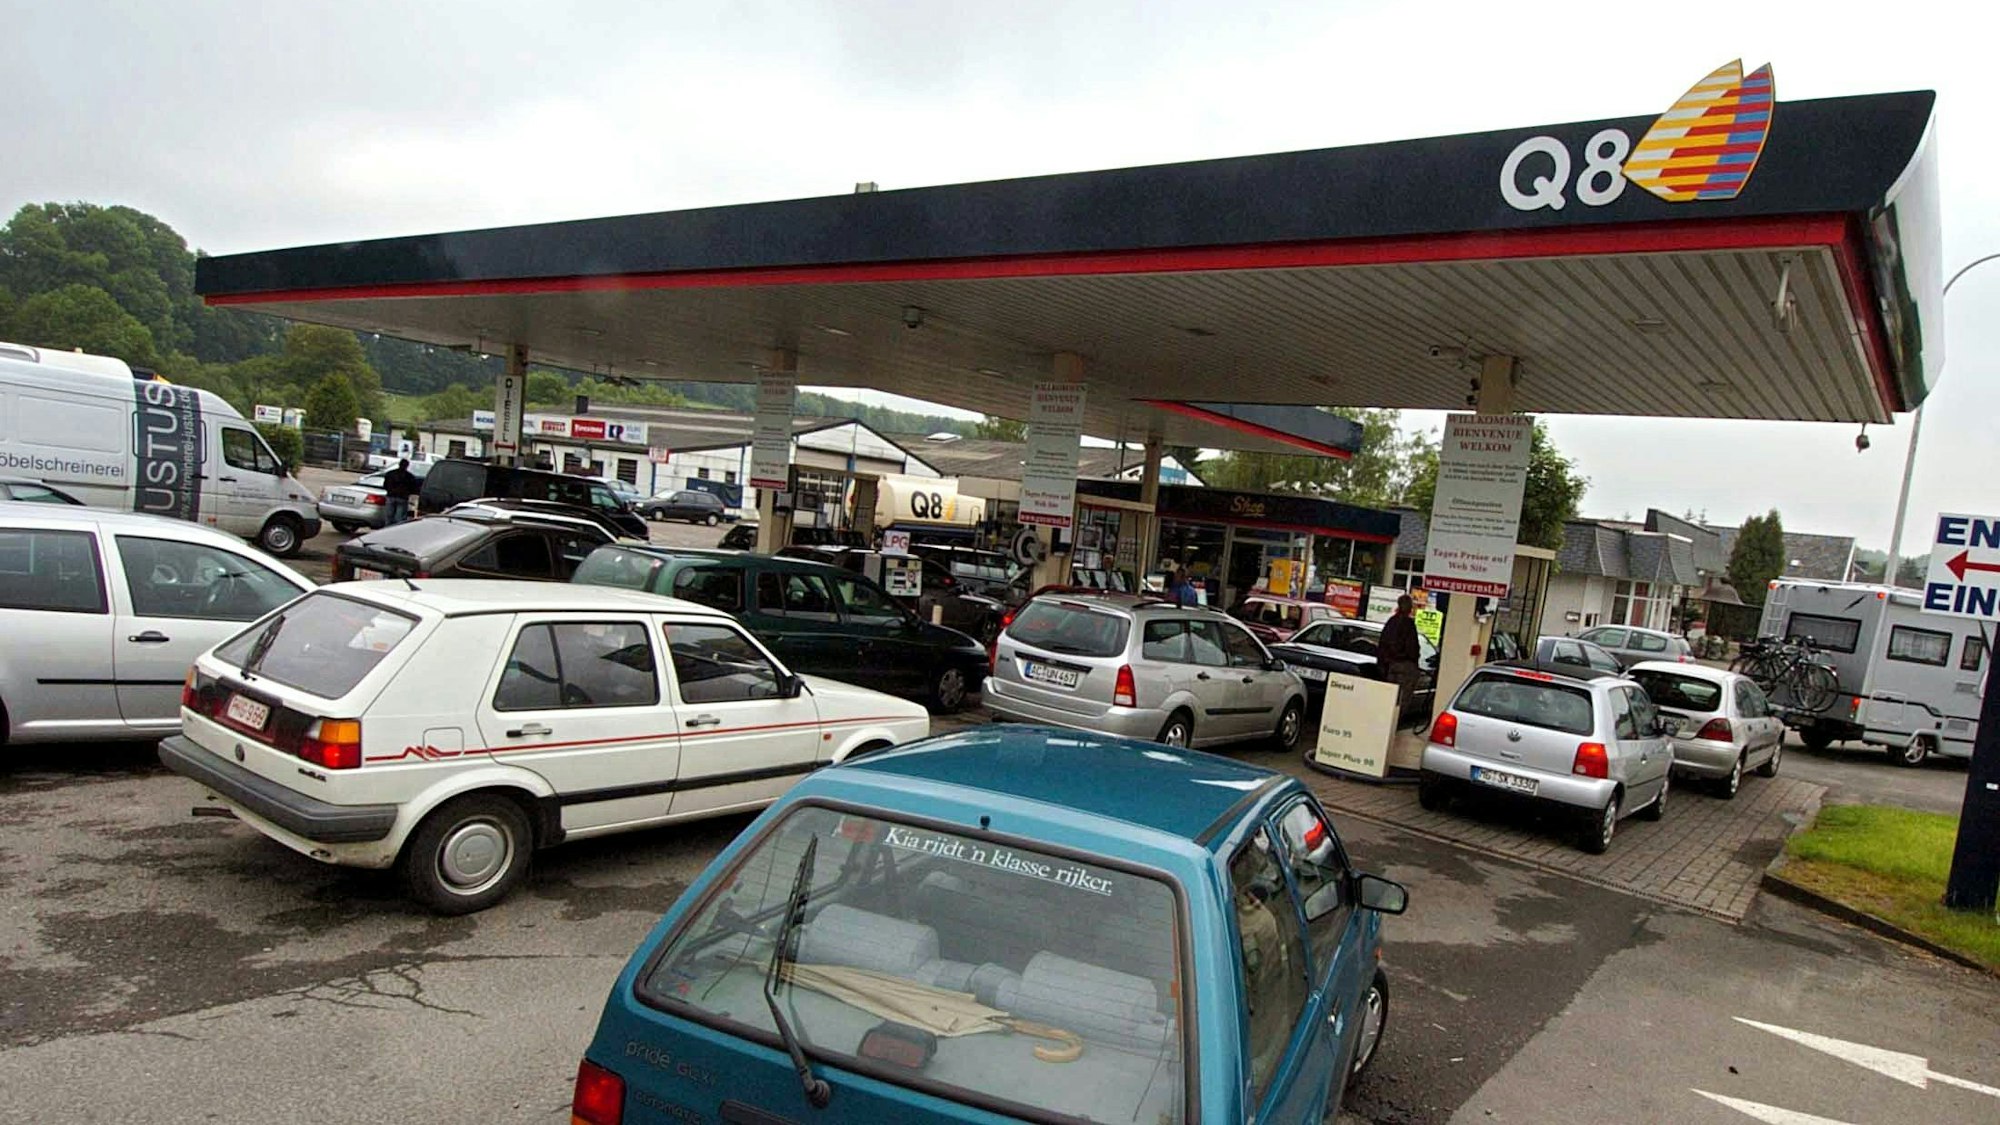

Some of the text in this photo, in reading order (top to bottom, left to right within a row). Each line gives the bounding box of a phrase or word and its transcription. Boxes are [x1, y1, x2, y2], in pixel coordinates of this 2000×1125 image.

[1500, 129, 1630, 211] Q8
[1447, 415, 1531, 427] WILLKOMMEN
[1453, 428, 1523, 440] BIENVENUE
[1459, 441, 1512, 453] WELKOM
[0, 451, 124, 477] öbelschreinerei
[911, 490, 943, 519] Q8
[883, 535, 909, 549] LPG
[1433, 548, 1508, 564] Tages Preise auf
[1448, 561, 1488, 573] Web Site
[1924, 582, 2000, 617] EIN
[1330, 680, 1354, 691] Diesel
[1322, 725, 1352, 739] Euro 95
[1319, 747, 1342, 758] Super
[1343, 752, 1362, 764] Plus
[884, 826, 920, 849] Kia
[923, 834, 965, 858] rijdt
[990, 849, 1051, 879] klasse
[1054, 866, 1113, 895] rijker.
[625, 1040, 671, 1069] pride
